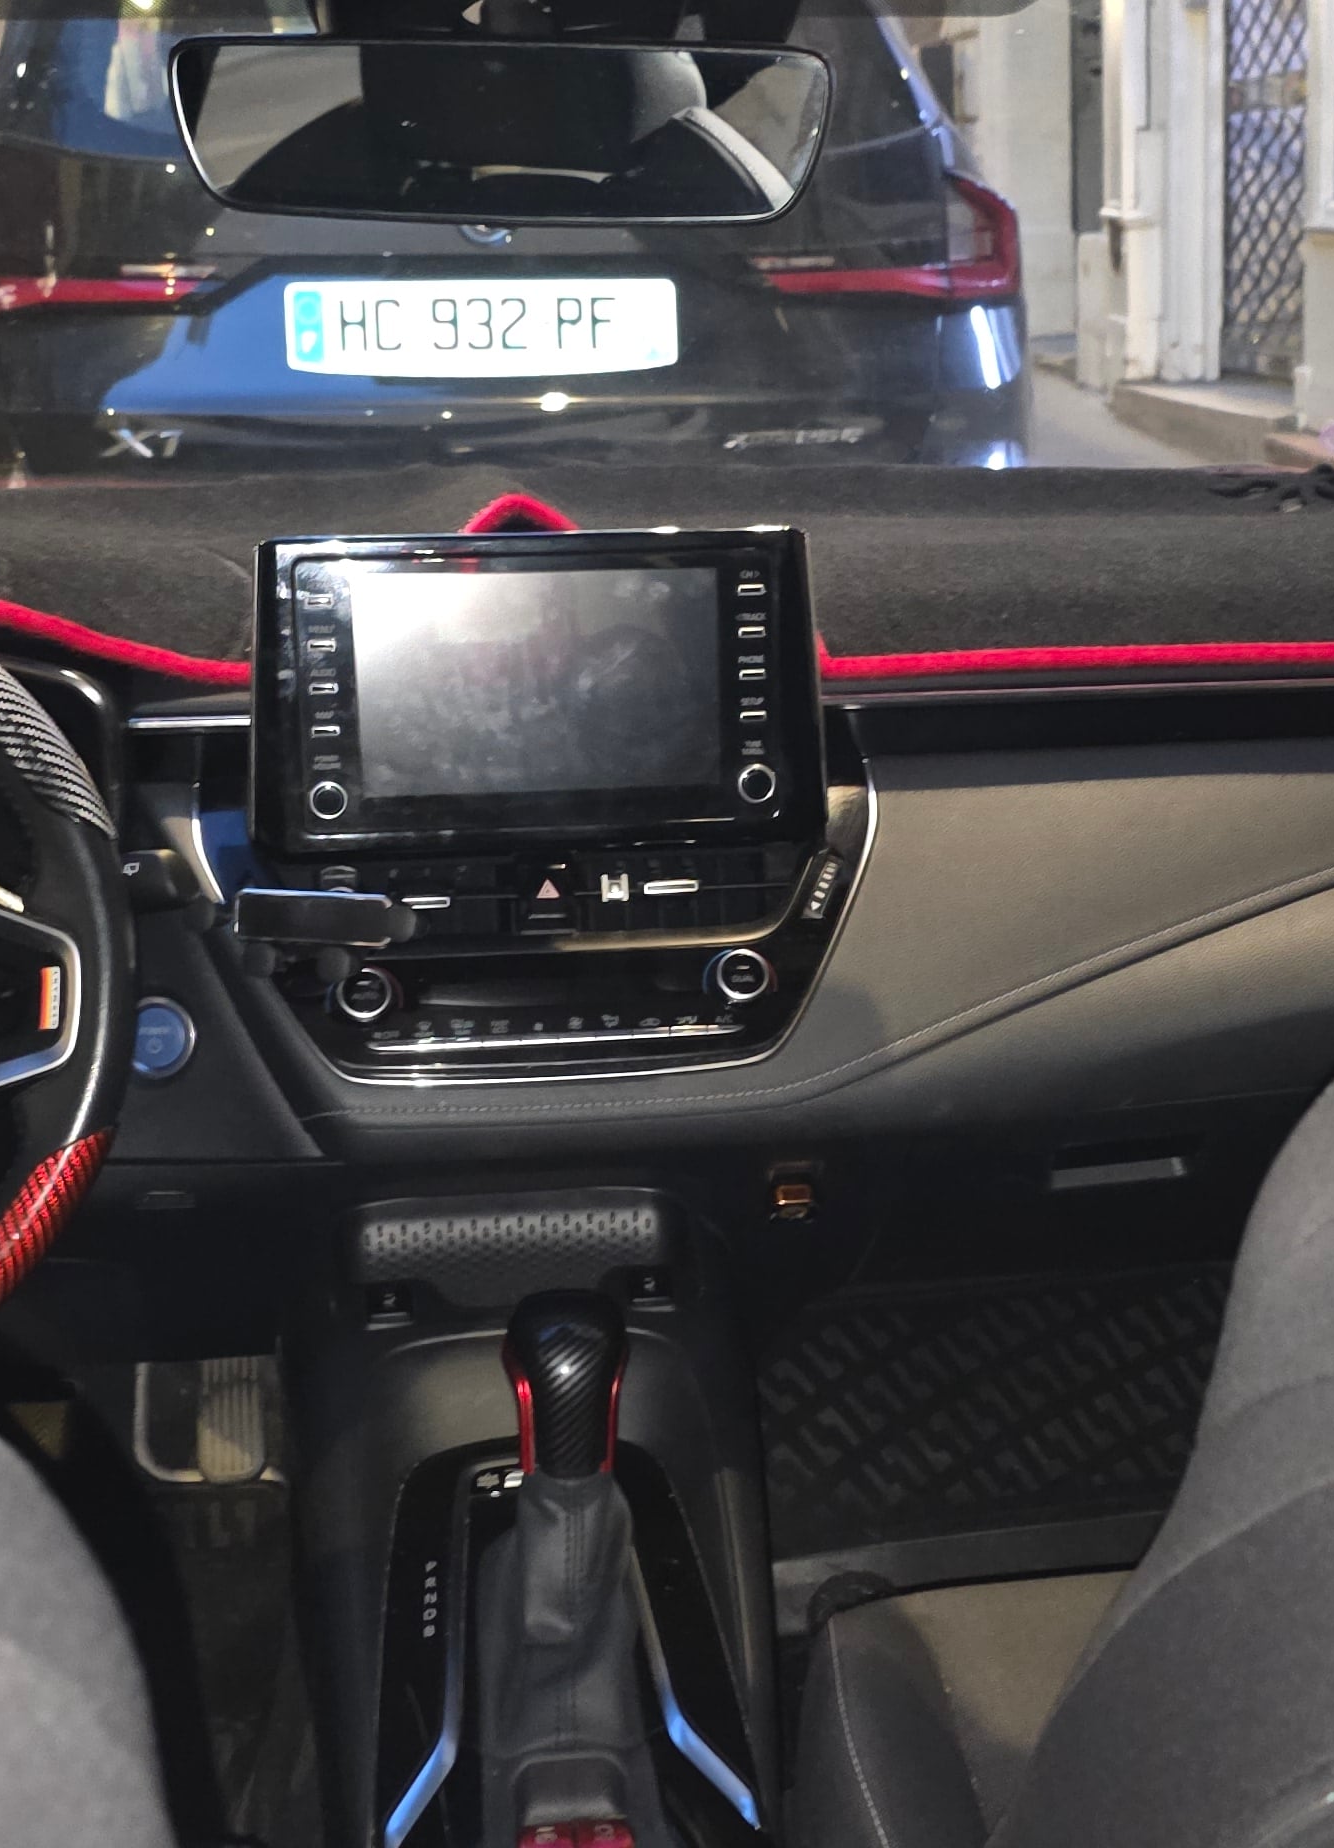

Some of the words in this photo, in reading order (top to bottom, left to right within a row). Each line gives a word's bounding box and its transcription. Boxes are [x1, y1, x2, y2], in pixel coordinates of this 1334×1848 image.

[339, 298, 402, 352] HC
[432, 297, 527, 351] 932
[556, 297, 616, 350] PF
[99, 428, 184, 459] X1
